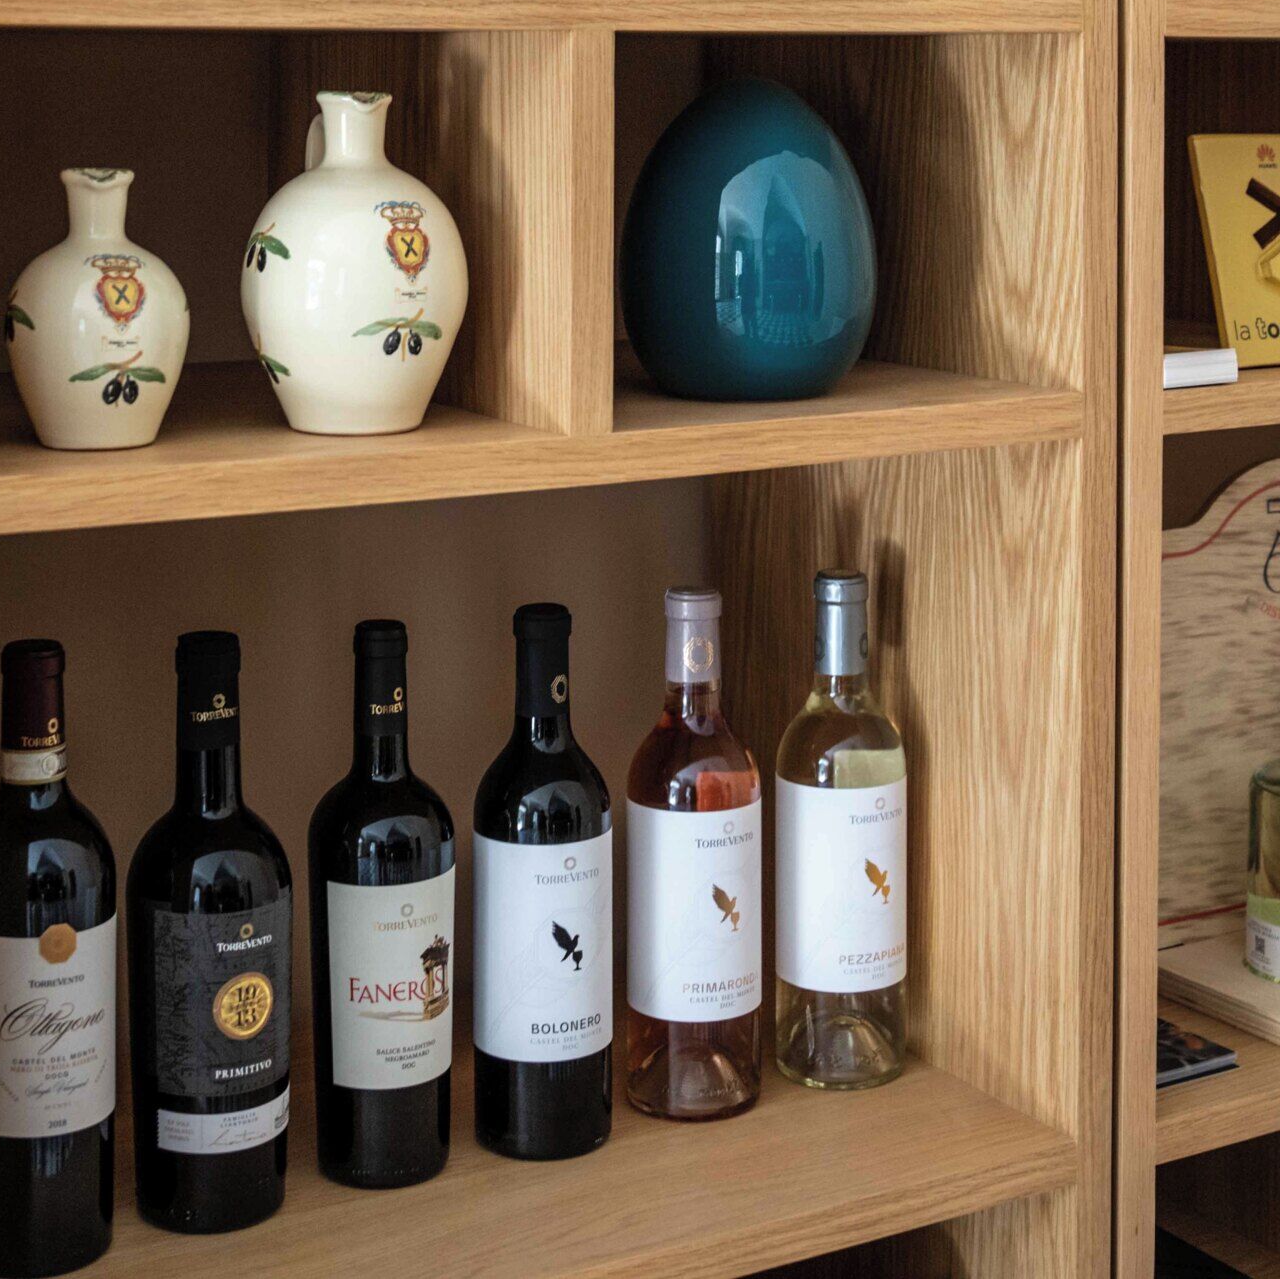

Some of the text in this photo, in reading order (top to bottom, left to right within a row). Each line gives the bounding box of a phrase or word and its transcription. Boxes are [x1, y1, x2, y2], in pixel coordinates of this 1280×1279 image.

[1234, 320, 1251, 341] la
[369, 702, 404, 716] TORREV
[21, 734, 60, 748] TORREV
[235, 984, 257, 1003] 19
[689, 996, 719, 1004] CASTEL
[721, 993, 734, 1001] DEL
[720, 1000, 736, 1009] DOC
[235, 1010, 257, 1027] 13
[531, 1013, 601, 1035] BOLONERO
[0, 998, 105, 1055] Ottagono
[530, 1037, 560, 1045] CASTEL
[564, 1034, 578, 1043] DEL
[376, 1039, 436, 1056] SALICE SALENTINO
[562, 1043, 579, 1051] DOC
[12, 1058, 46, 1066] CASTEL
[70, 1047, 96, 1059] MONTE
[385, 1049, 430, 1063] NEGROAMARO
[215, 1059, 272, 1080] PRIMITIVO
[401, 1061, 416, 1070] DOC
[45, 1072, 69, 1080] DOCG
[48, 1120, 67, 1129] 2018
